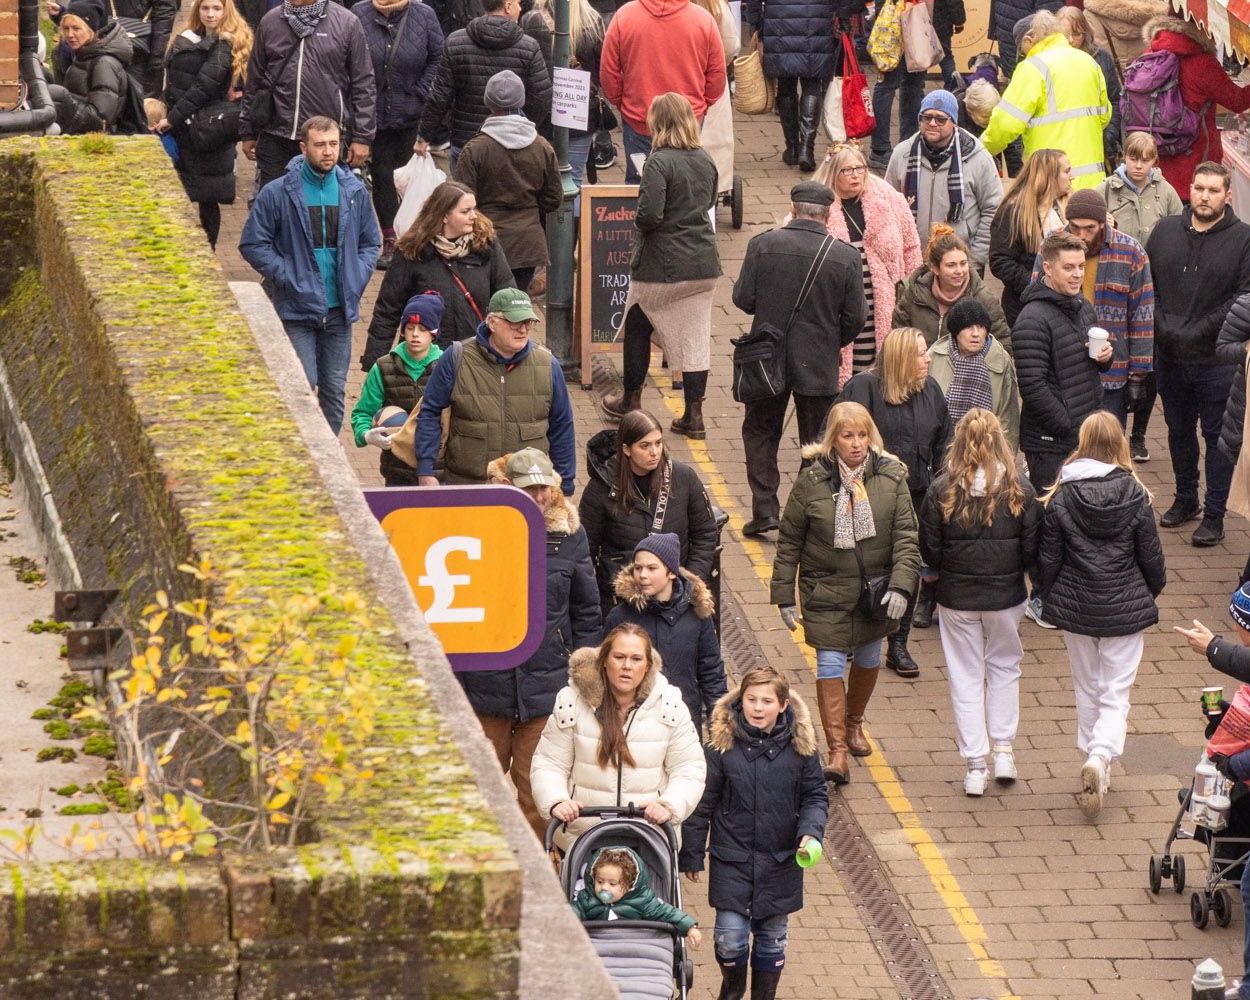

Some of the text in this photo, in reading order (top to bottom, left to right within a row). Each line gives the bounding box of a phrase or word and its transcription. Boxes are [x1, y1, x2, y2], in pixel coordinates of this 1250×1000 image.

[565, 92, 575, 100] ALL
[576, 94, 588, 102] DAY
[595, 206, 636, 222] Zucke
[597, 230, 634, 241] A LITTL
[606, 251, 632, 266] AUS
[598, 274, 632, 288] TRADI
[610, 312, 622, 330] C
[657, 490, 668, 513] LOLA
[418, 535, 486, 624] £
